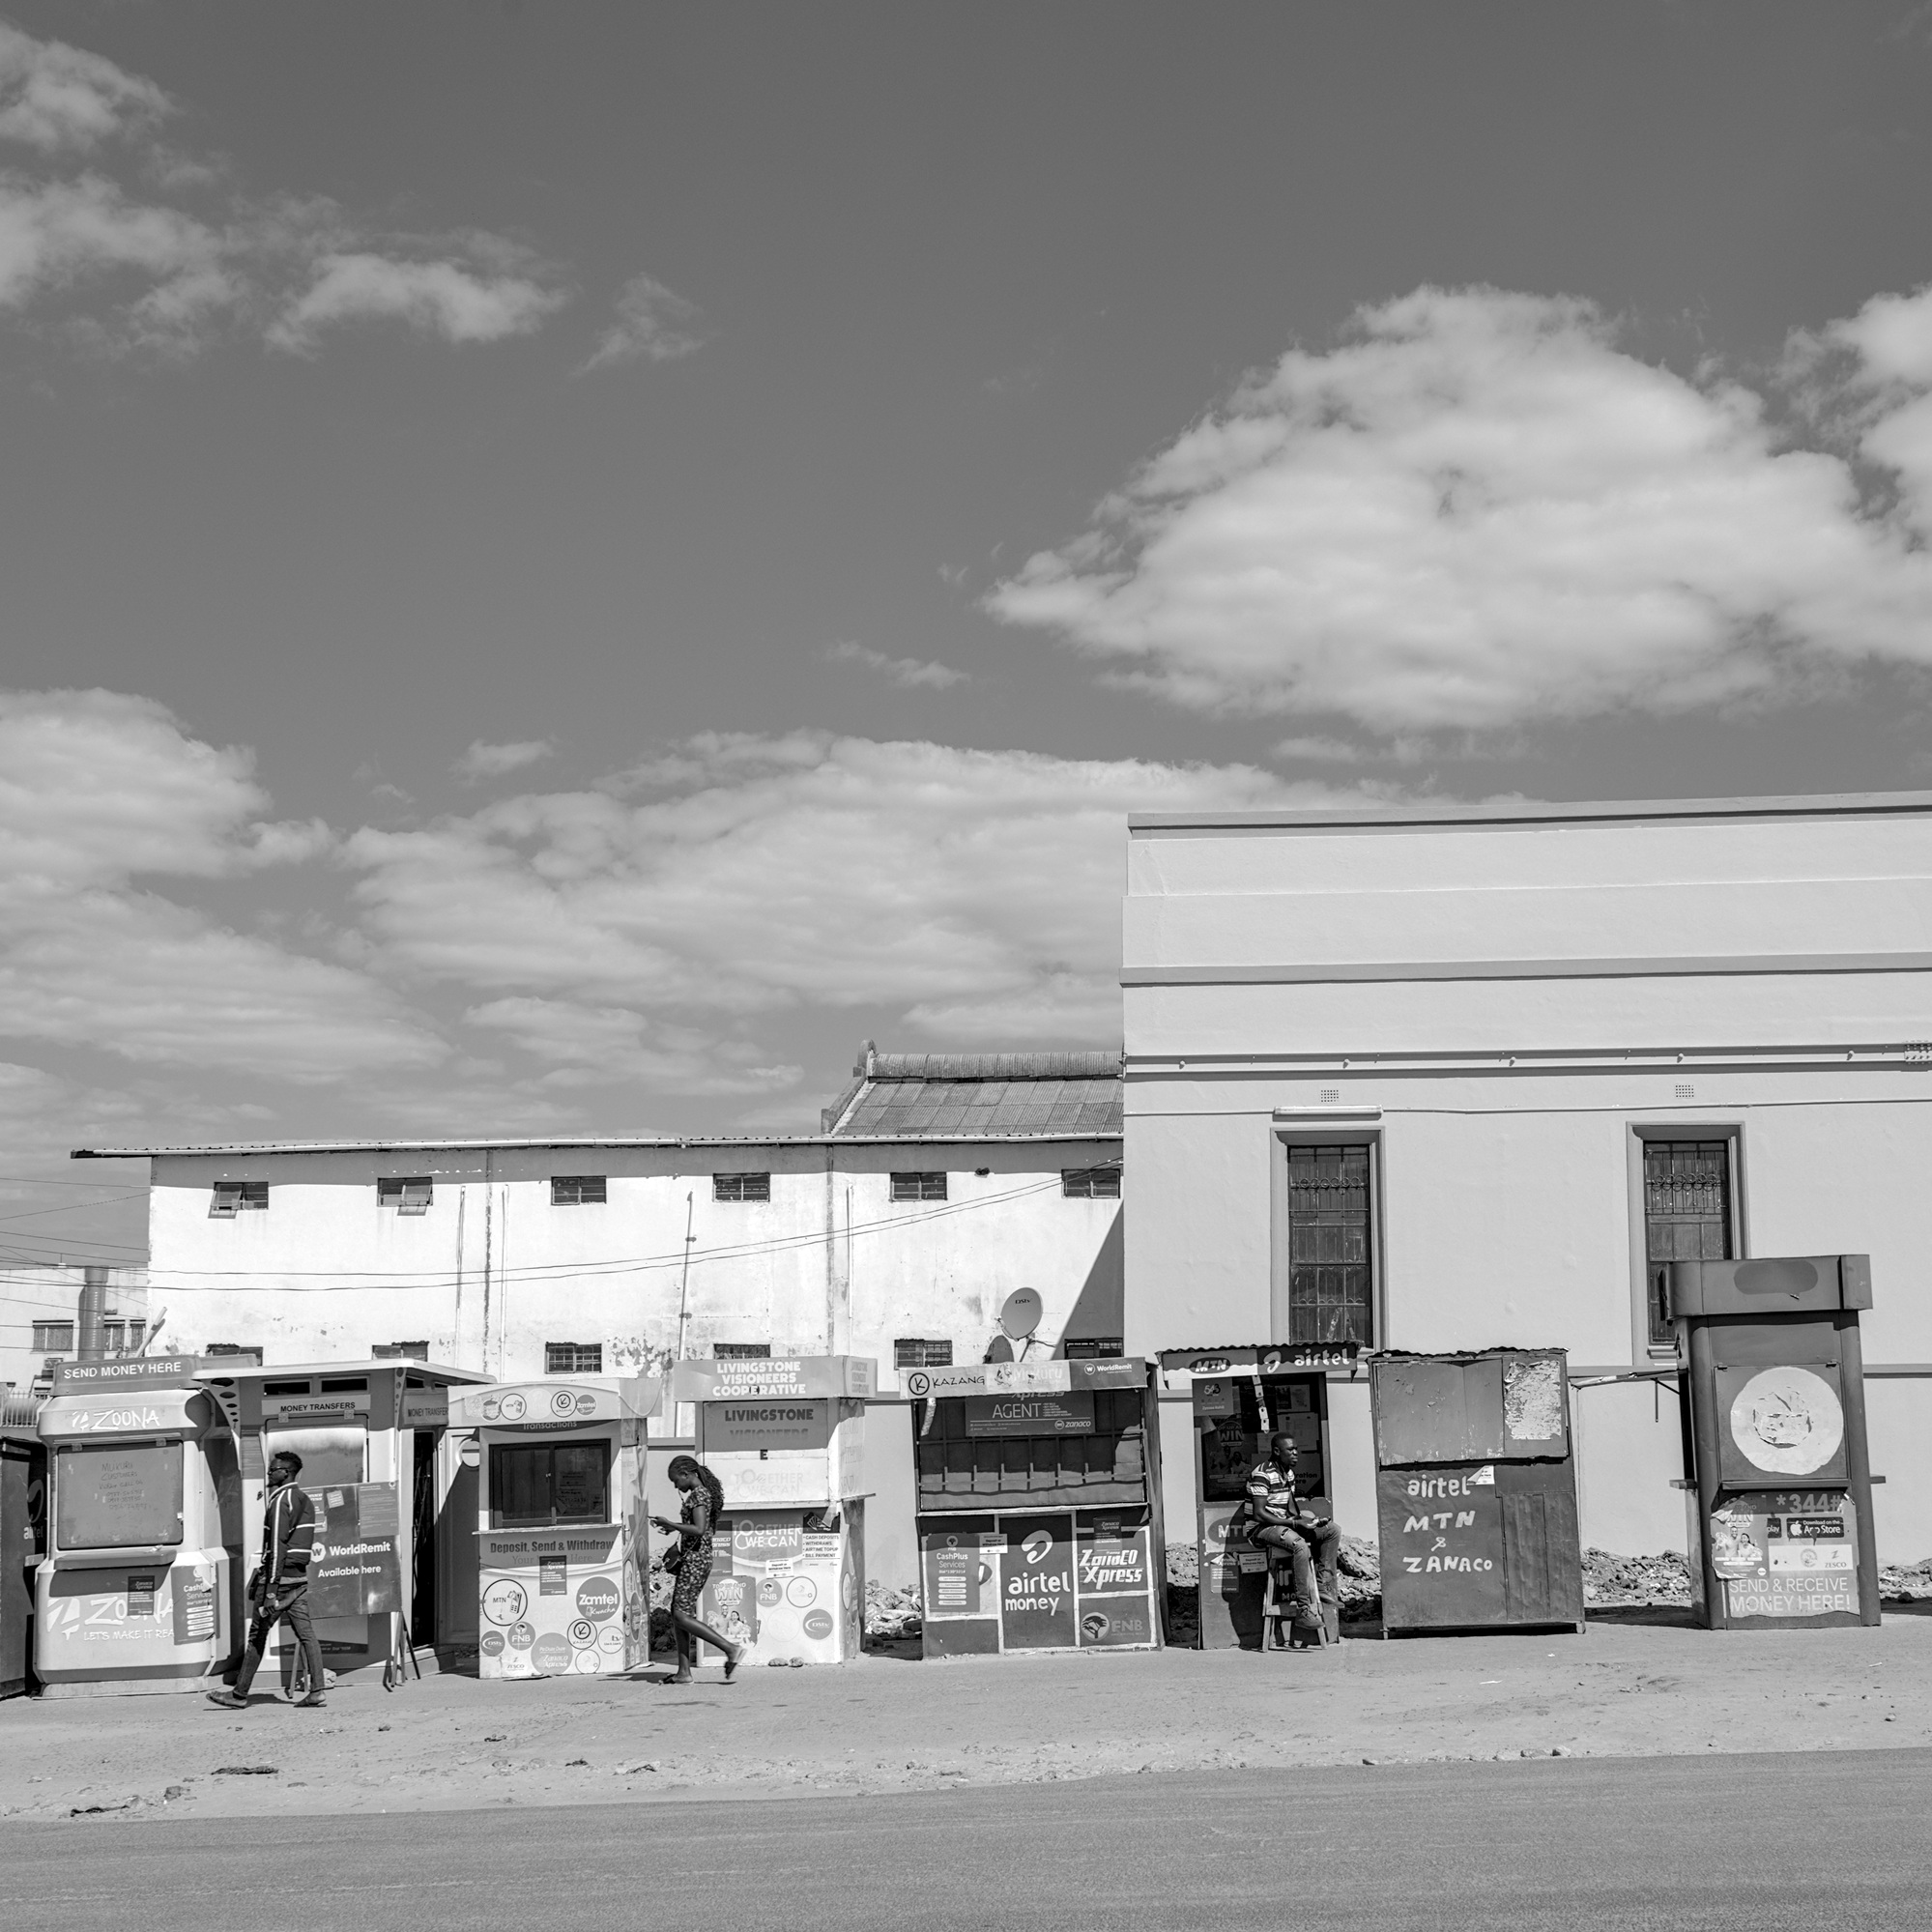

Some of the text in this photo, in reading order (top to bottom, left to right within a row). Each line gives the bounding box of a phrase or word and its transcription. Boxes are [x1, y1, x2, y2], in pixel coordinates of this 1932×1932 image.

[1294, 1348, 1350, 1367] airtel
[64, 1362, 182, 1379] SEND MONEY HERE
[716, 1362, 801, 1374] LIVINGSTONE
[1096, 1363, 1133, 1372] WorldRemit
[1195, 1359, 1228, 1373] MTN
[722, 1372, 796, 1385] VISIONEERS
[933, 1375, 986, 1388] KAZANG
[712, 1383, 806, 1397] COOPERATIVE
[309, 1401, 356, 1411] TRANSFERS
[407, 1406, 448, 1418] MONEY TRANSFER
[992, 1402, 1042, 1419] AGENT
[90, 1407, 160, 1430] ZOONA
[724, 1408, 814, 1422] LIVINGSTONE
[523, 1420, 577, 1430] Transactions
[1217, 1429, 1244, 1441] WIN
[1407, 1474, 1471, 1498] airtel
[733, 1519, 803, 1536] TOGETHER
[1403, 1510, 1476, 1533] MTN
[329, 1541, 391, 1556] WorldRemit
[490, 1540, 615, 1554] Deposit, Send & Withdraw
[512, 1555, 534, 1565] Your
[570, 1554, 592, 1563] Here
[938, 1560, 966, 1569] Services
[1402, 1555, 1493, 1573] ZANACO
[317, 1565, 382, 1578] Available here
[1082, 1566, 1143, 1591] Xpress
[1008, 1572, 1071, 1595] airtel
[1729, 1577, 1849, 1593] SEND & RECEIVE
[578, 1593, 619, 1605] Zamtel
[714, 1587, 743, 1601] WIN
[1005, 1598, 1060, 1617] money
[1730, 1594, 1851, 1612] MONEY HERE!
[1111, 1619, 1143, 1631] FNB
[112, 1629, 142, 1640] MAKE
[144, 1629, 154, 1639] IT
[155, 1628, 174, 1638] REA
[511, 1634, 532, 1643] FNB
